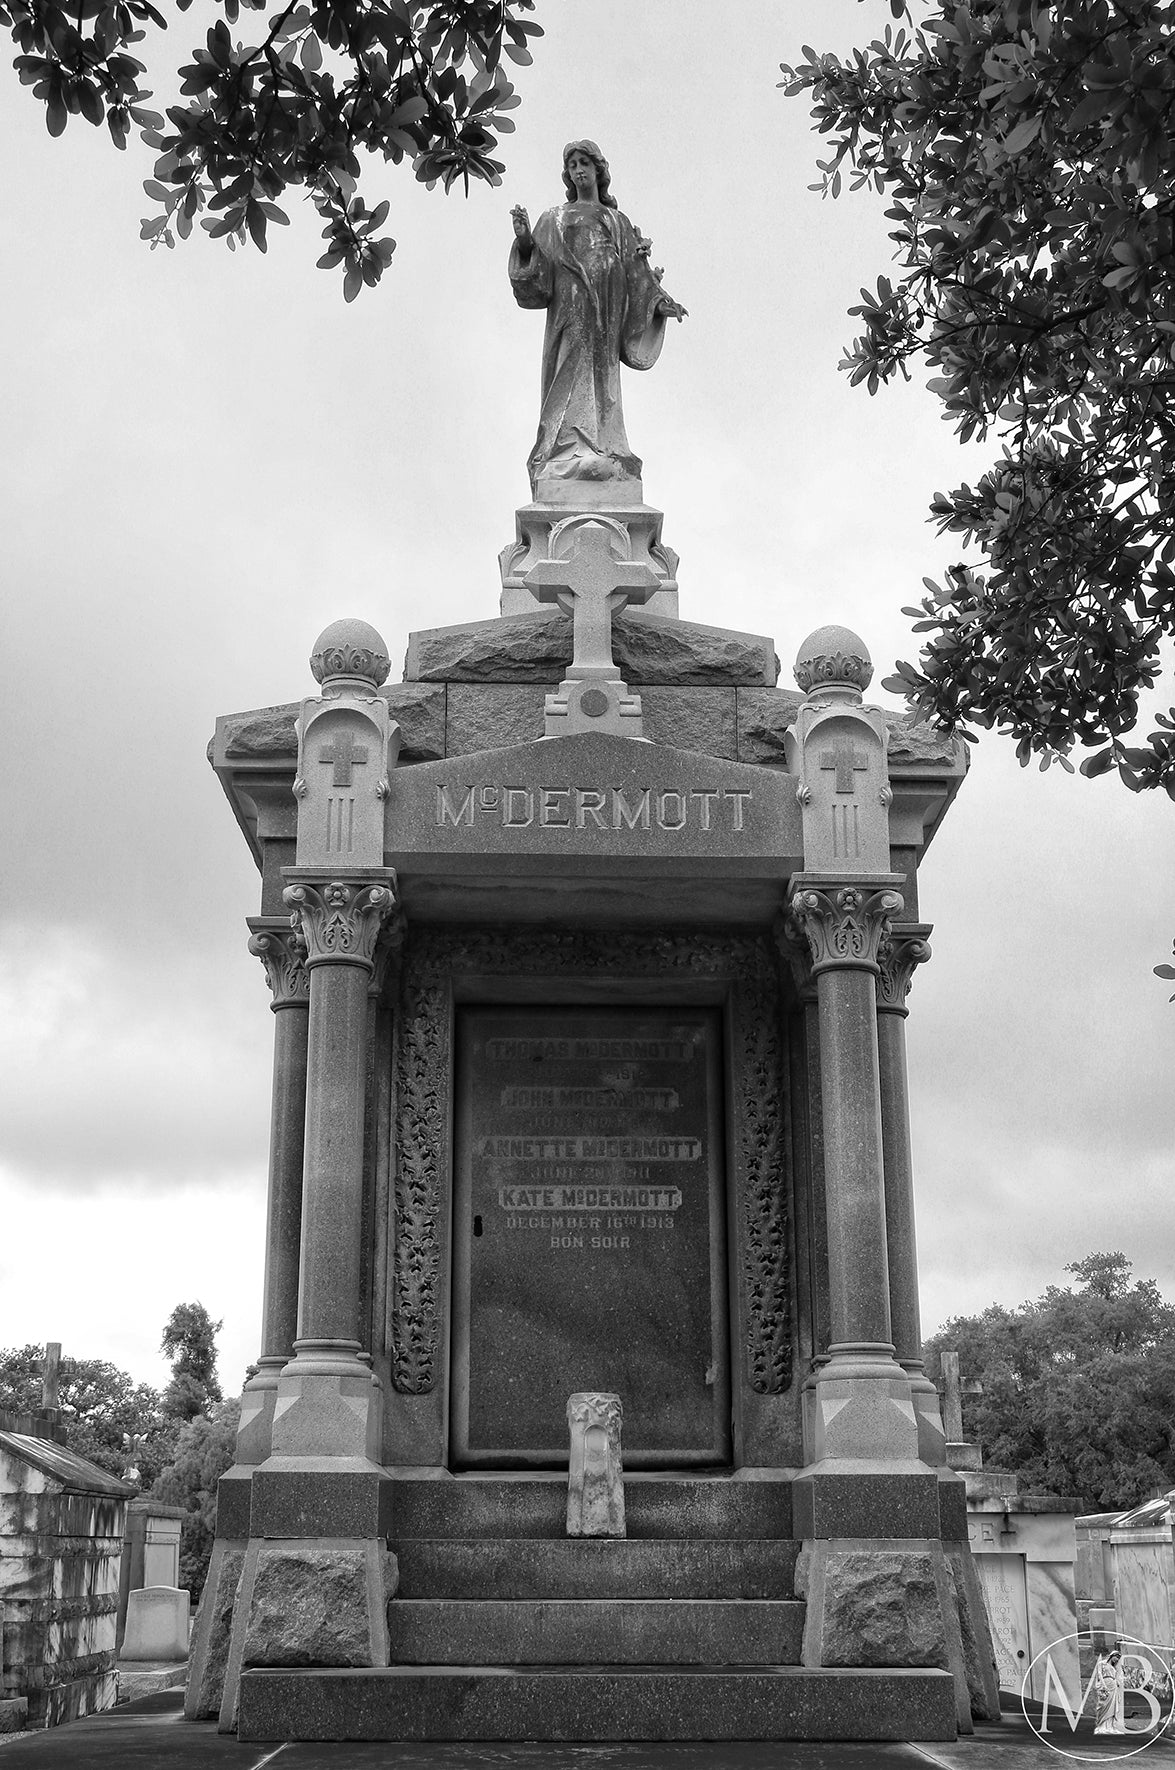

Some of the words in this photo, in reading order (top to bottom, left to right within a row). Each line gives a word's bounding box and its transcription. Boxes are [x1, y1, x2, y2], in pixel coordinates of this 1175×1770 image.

[482, 1139, 577, 1158] ANNETTE
[503, 1189, 555, 1207] KATE
[506, 1216, 600, 1229] DECEMBER
[550, 1236, 584, 1249] BON
[591, 1236, 631, 1249] SOIR
